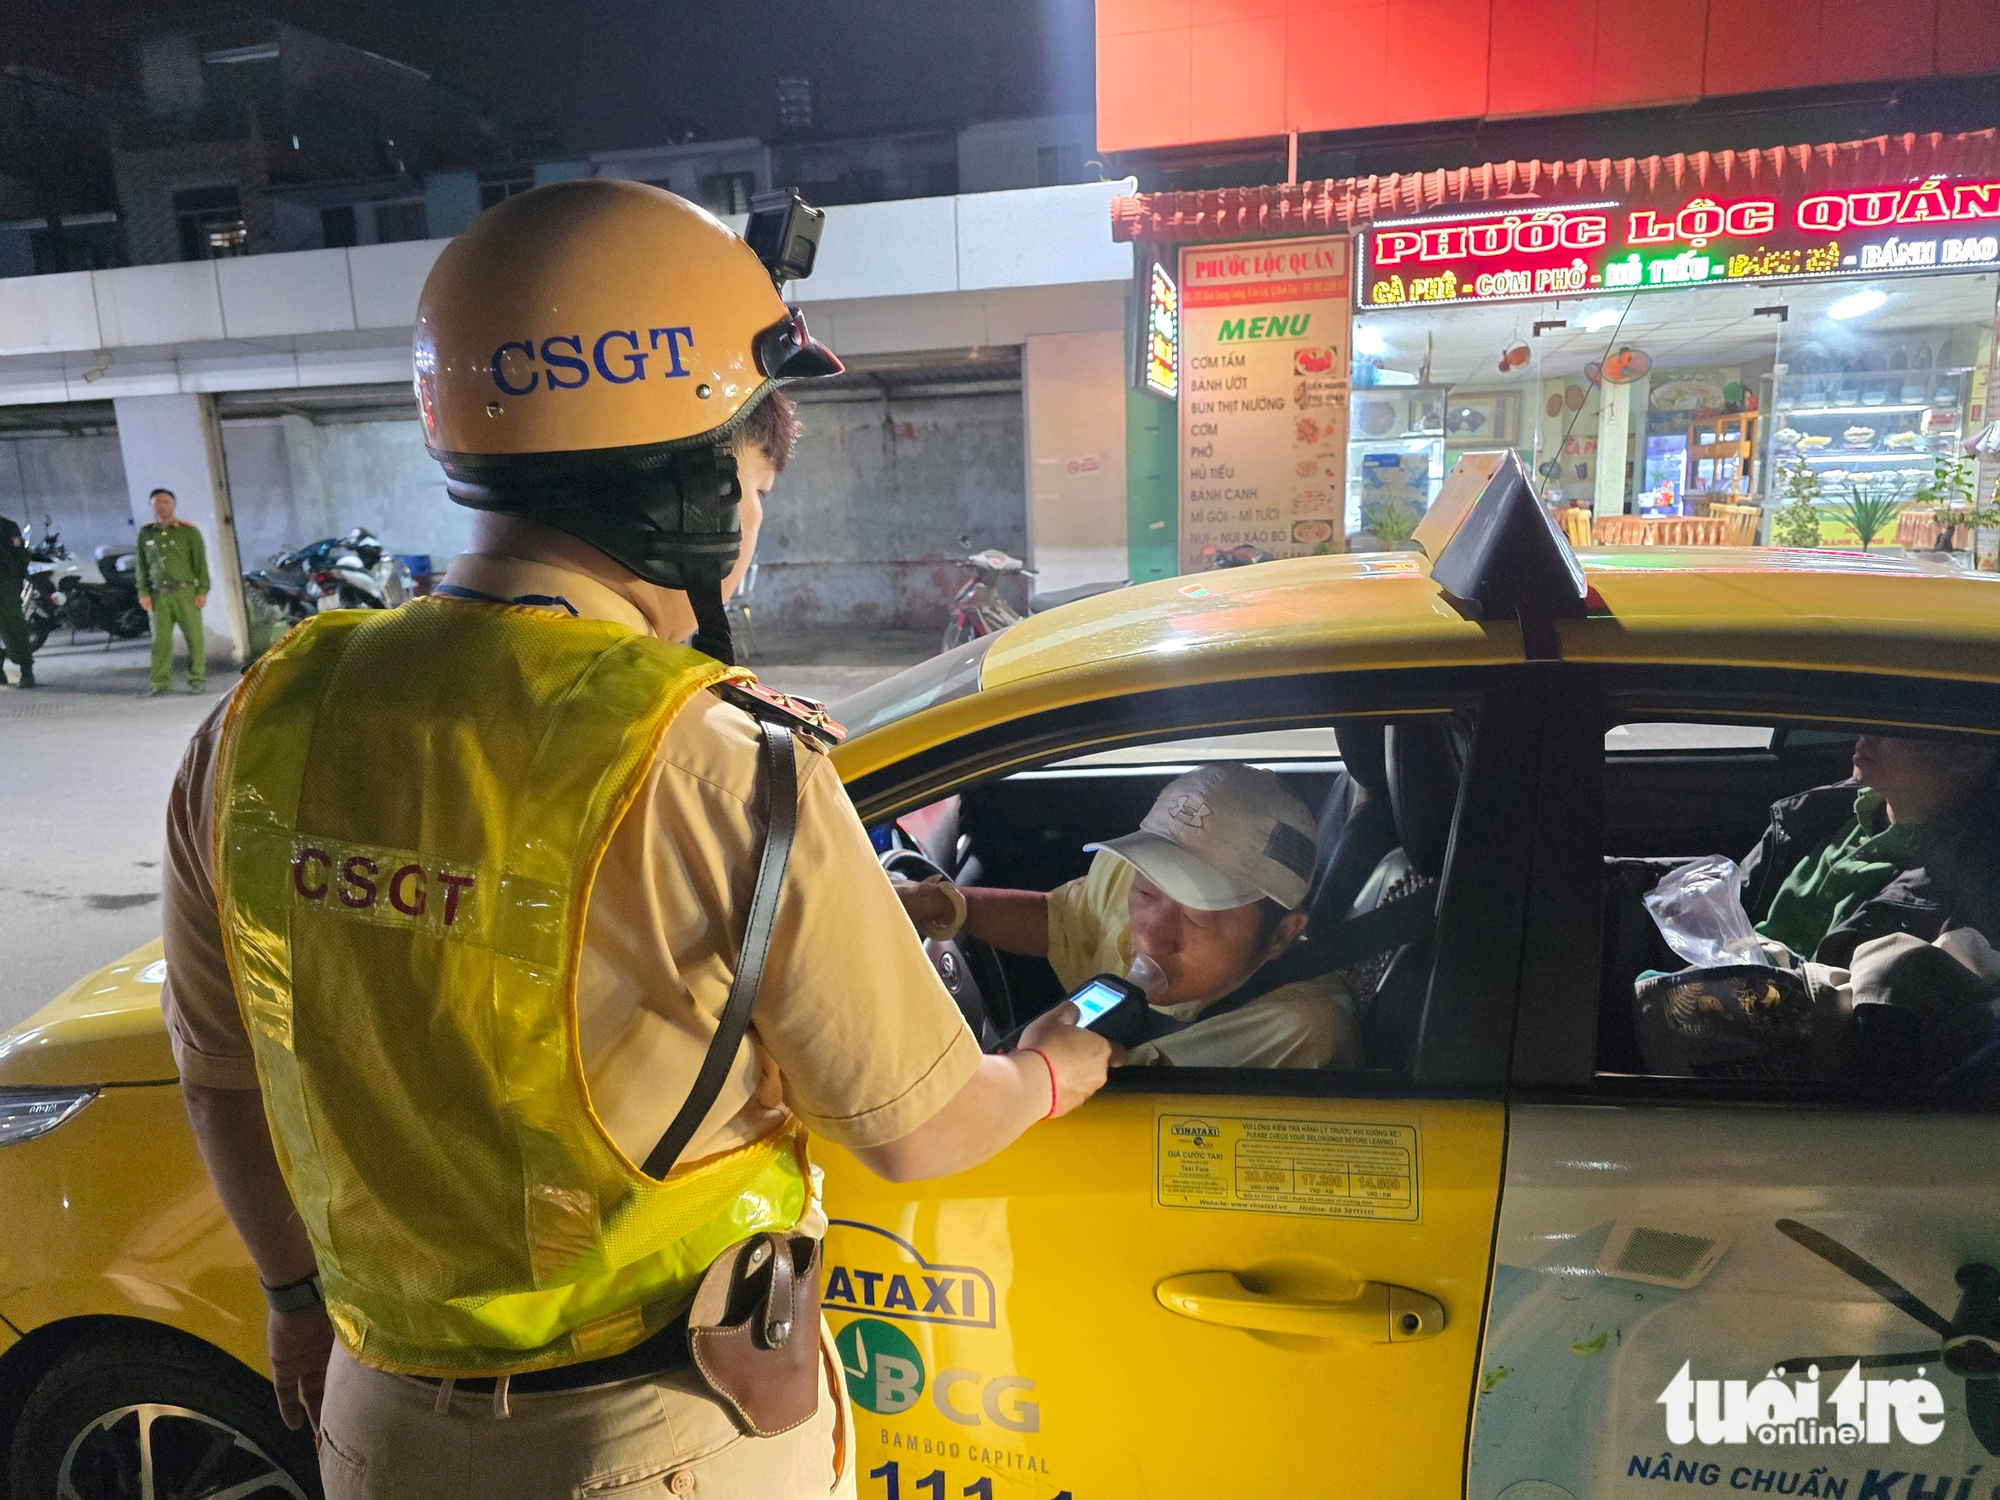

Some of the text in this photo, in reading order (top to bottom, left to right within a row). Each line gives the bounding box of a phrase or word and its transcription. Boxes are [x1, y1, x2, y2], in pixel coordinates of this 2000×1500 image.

[1375, 179, 2000, 265] PHƯỚC LỘC QUÁN
[1195, 247, 1336, 279] PHƯỚC LỘC QUÁN
[1409, 269, 1457, 301] PHÊ
[1475, 269, 1532, 296] CƠM
[1535, 258, 1589, 292] PHỞ
[1860, 236, 1937, 268] BÁNH
[1941, 237, 1999, 263] BAO
[1217, 314, 1311, 341] MENU
[490, 326, 694, 396] CSGT
[1191, 351, 1246, 370] CƠM TẤM
[1191, 375, 1222, 392] BÁNH
[1191, 398, 1215, 414] BÚN
[1218, 400, 1238, 416] THỊT
[1191, 423, 1218, 436] CƠM
[1191, 441, 1214, 458] PHỞ
[1190, 462, 1234, 480] HỦ TIẾU
[1191, 486, 1257, 501] BÁNH CANH
[1220, 532, 1241, 544] NUI
[293, 848, 475, 926] CSGT
[1174, 1126, 1218, 1136] VINATAXI
[1246, 1131, 1268, 1139] PLEASE
[1269, 1132, 1288, 1140] CHECK
[1290, 1133, 1306, 1141] YOUR
[1307, 1134, 1344, 1143] BELONGINGS
[1369, 1138, 1394, 1146] LEAVING
[1195, 1165, 1209, 1173] Fare
[824, 1266, 976, 1318] ATAXI
[875, 1353, 1040, 1433] BCG
[881, 1428, 1050, 1474] BAMBOO CAPITAL
[1627, 1451, 1722, 1485] NÂNG
[1729, 1465, 1849, 1500] CHUẨN
